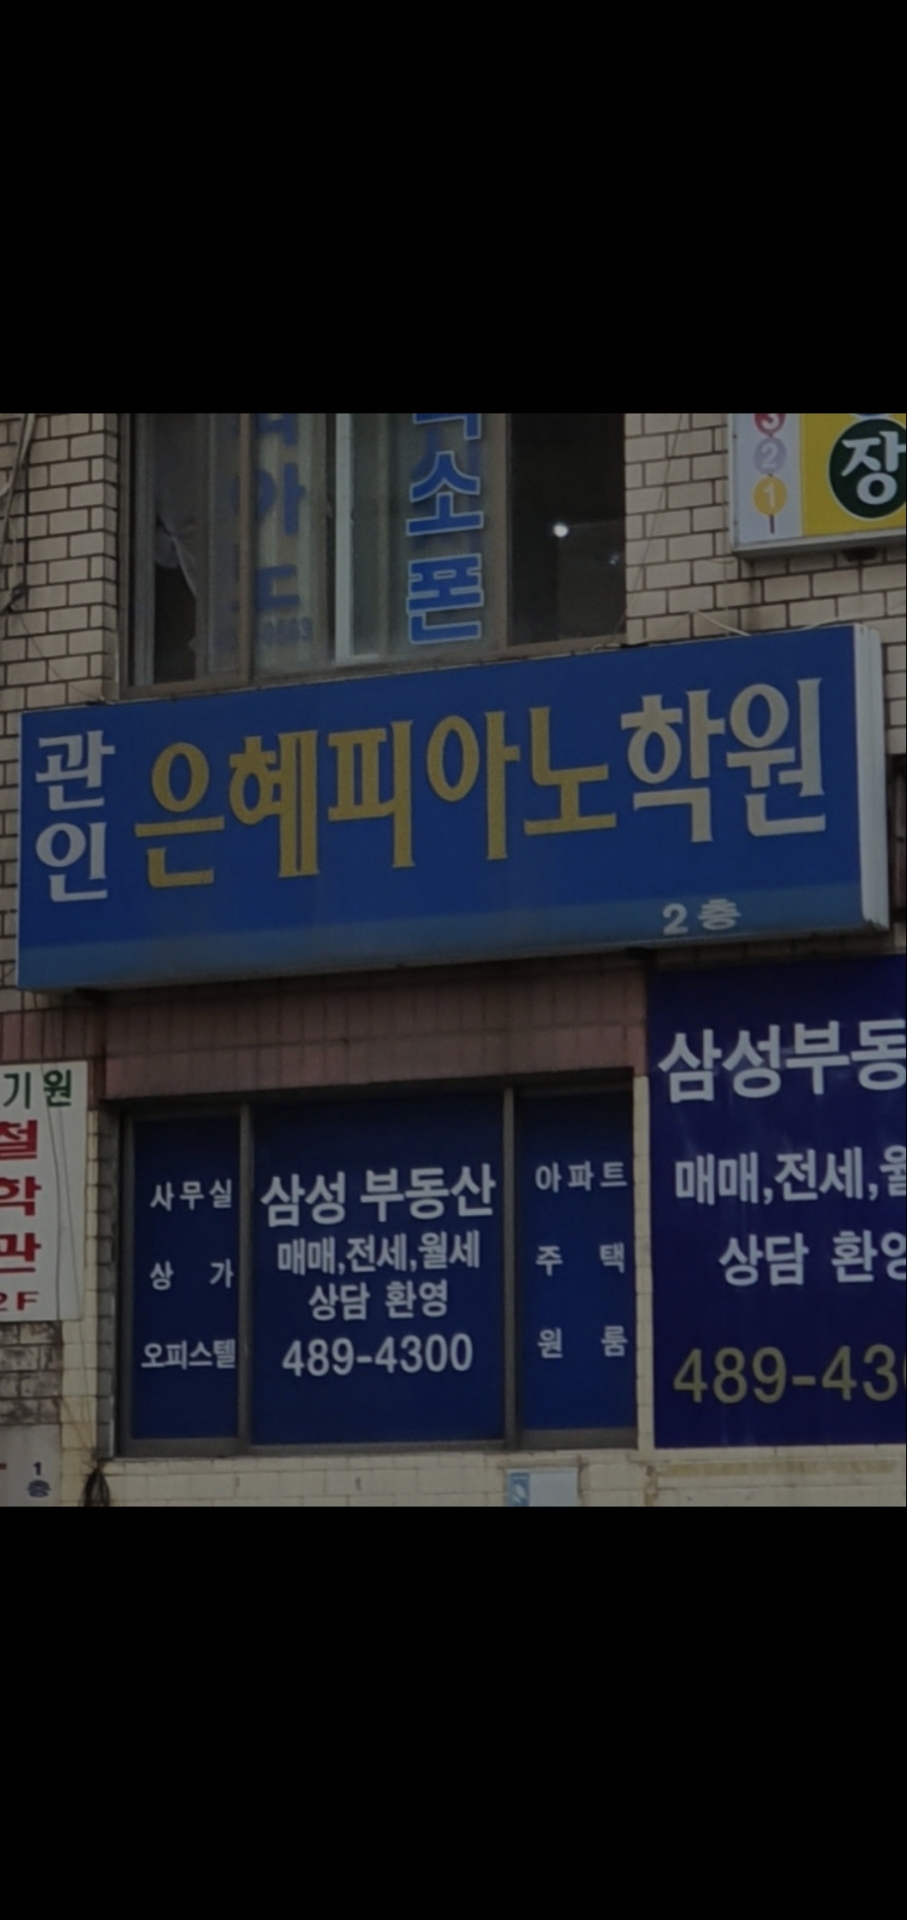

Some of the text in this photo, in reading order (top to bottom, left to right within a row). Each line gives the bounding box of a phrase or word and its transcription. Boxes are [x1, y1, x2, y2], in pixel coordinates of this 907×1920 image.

[760, 442, 778, 470] 2
[841, 430, 907, 505] 장
[762, 481, 777, 510] 1
[134, 678, 827, 888] 은혜피아노학원
[35, 730, 116, 902] 관인
[662, 898, 741, 936] 2층
[3, 1069, 72, 1109] 기원
[150, 1178, 233, 1211] 사무실
[260, 1163, 496, 1227] 삼성 부동산
[535, 1160, 628, 1193] 아파트
[276, 1229, 481, 1276] 매매,전세,월세
[719, 1232, 809, 1286] 상담
[309, 1279, 448, 1321] 상담 환영
[140, 1338, 236, 1370] 오피스텔
[282, 1333, 473, 1377] 489-4300
[673, 1344, 907, 1404] 489-43
